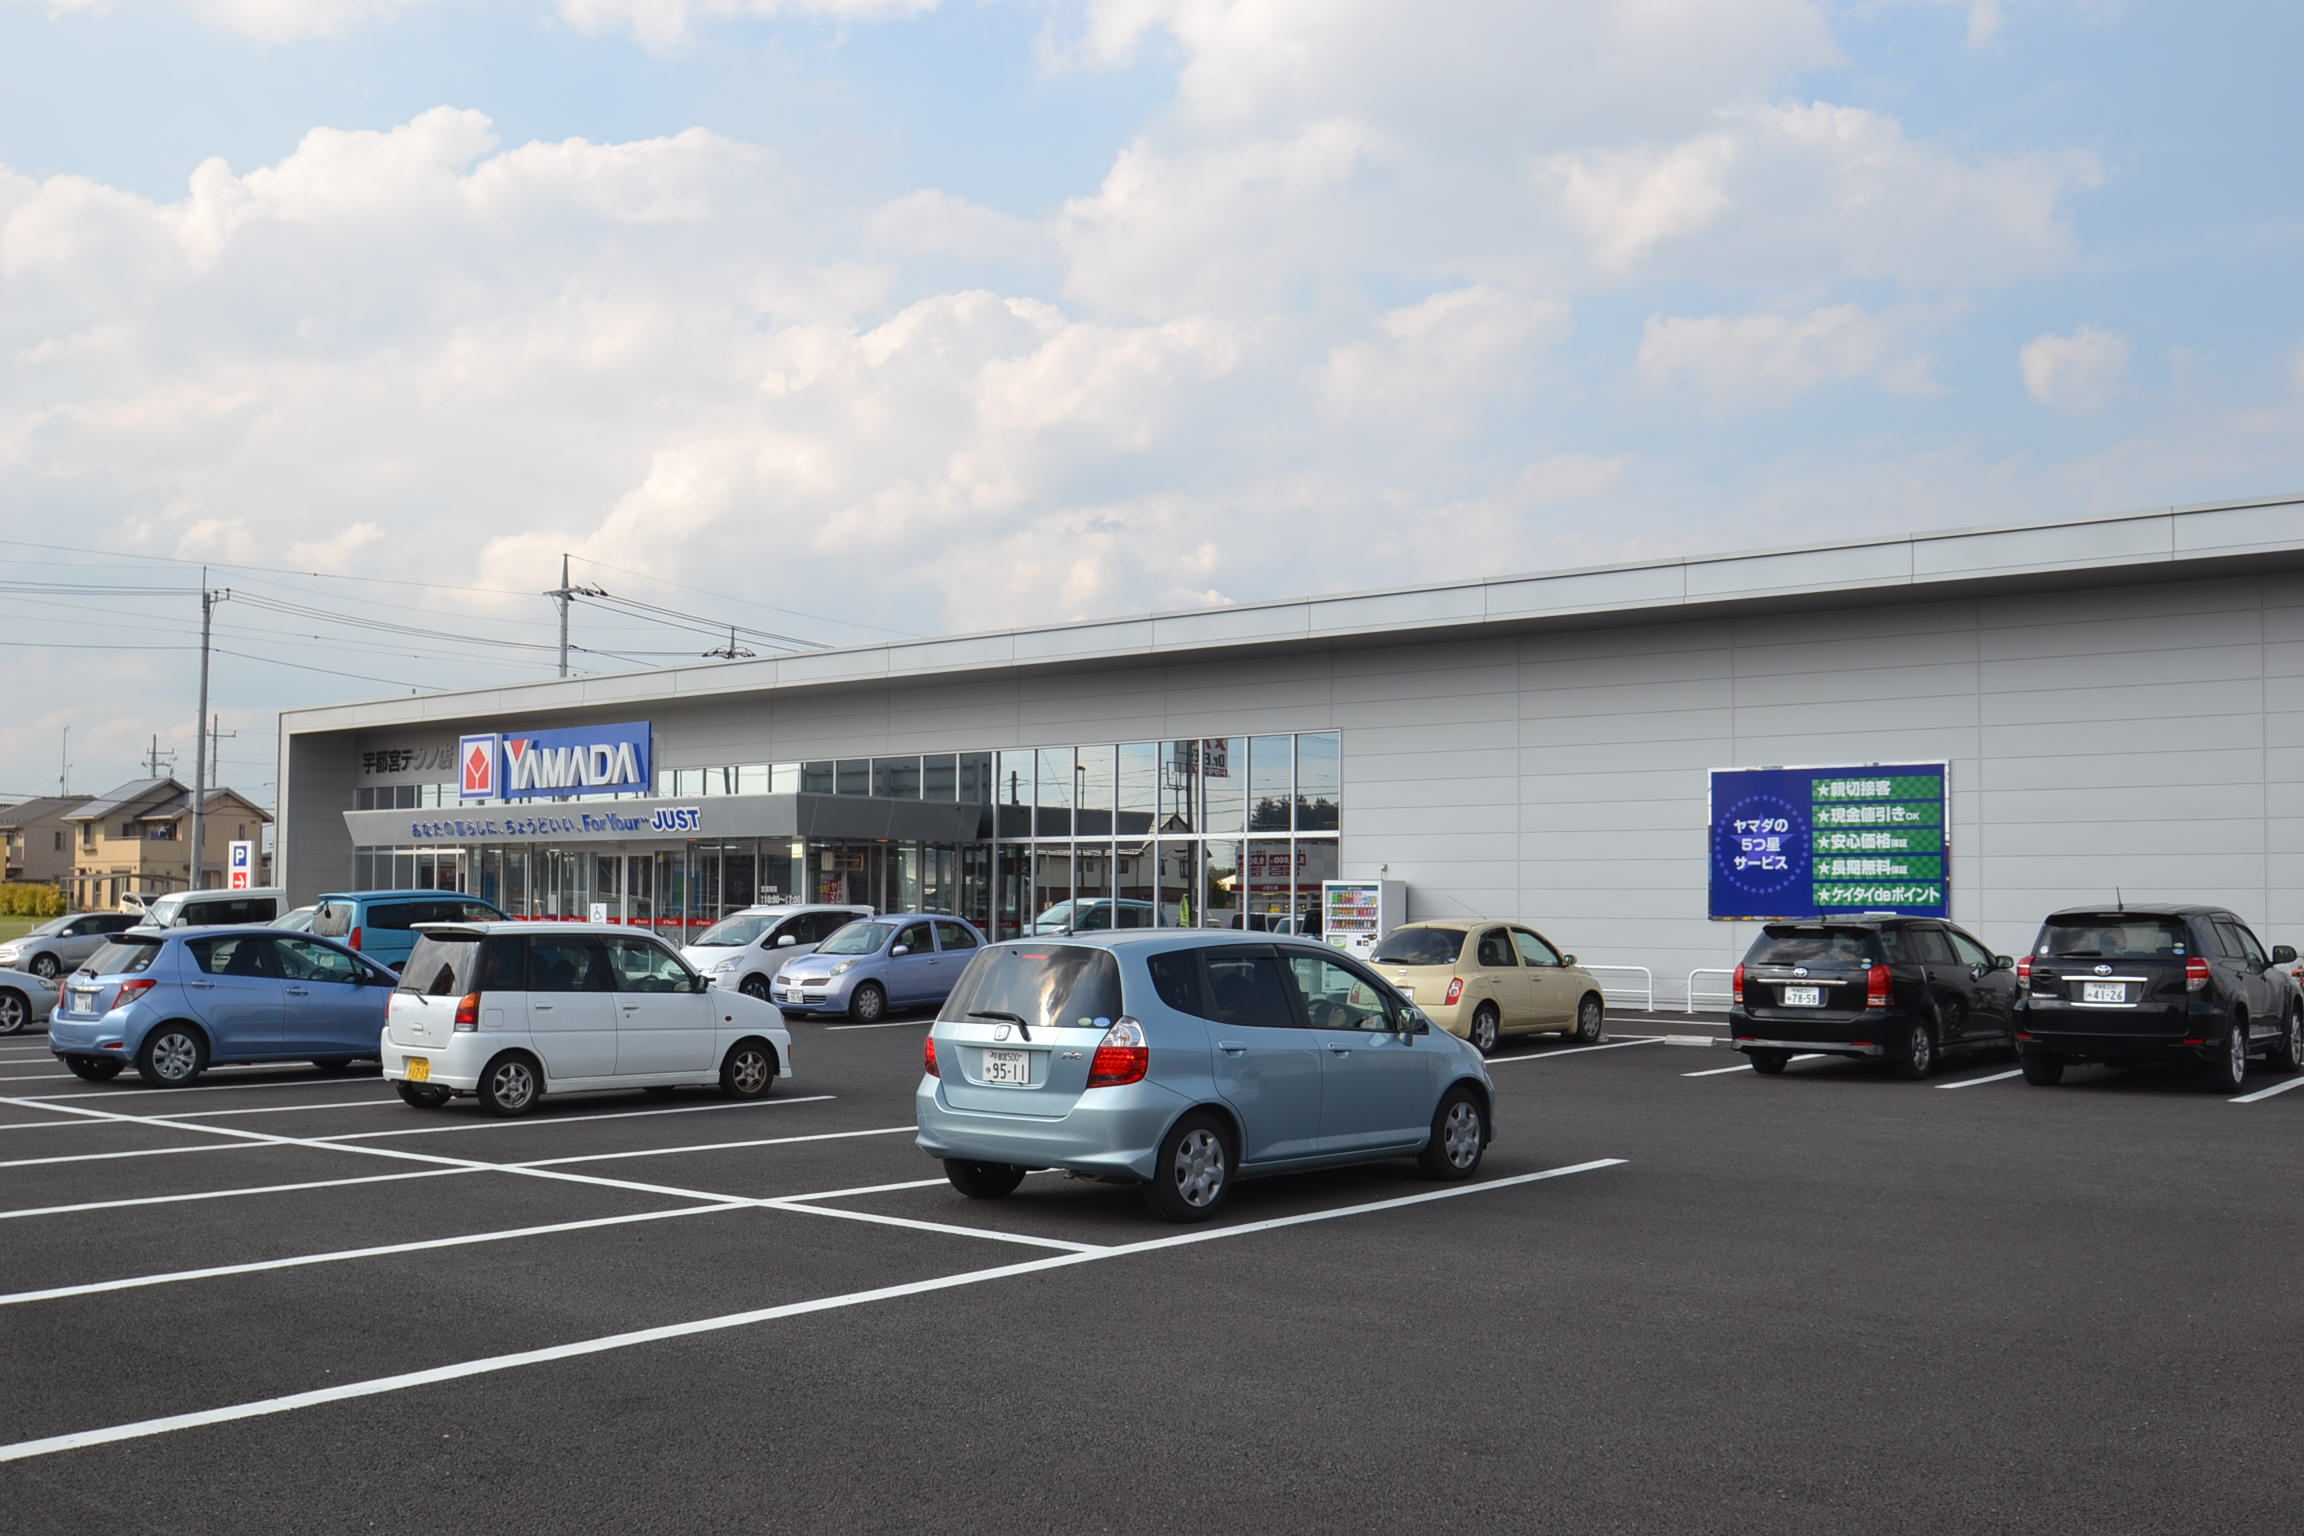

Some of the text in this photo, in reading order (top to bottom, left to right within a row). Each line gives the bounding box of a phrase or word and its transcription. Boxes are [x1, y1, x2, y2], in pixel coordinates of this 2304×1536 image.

[503, 739, 640, 790] YAMADA
[1830, 780, 1891, 797] 親切接客
[651, 807, 700, 832] JUST
[1733, 818, 1789, 834] ヤマダの
[1741, 837, 1781, 852] 5つ星
[235, 848, 245, 864] P
[1733, 855, 1789, 871] サービス
[1831, 886, 1941, 903] ケイタイdeポイント
[992, 1062, 1025, 1081] 95-11
